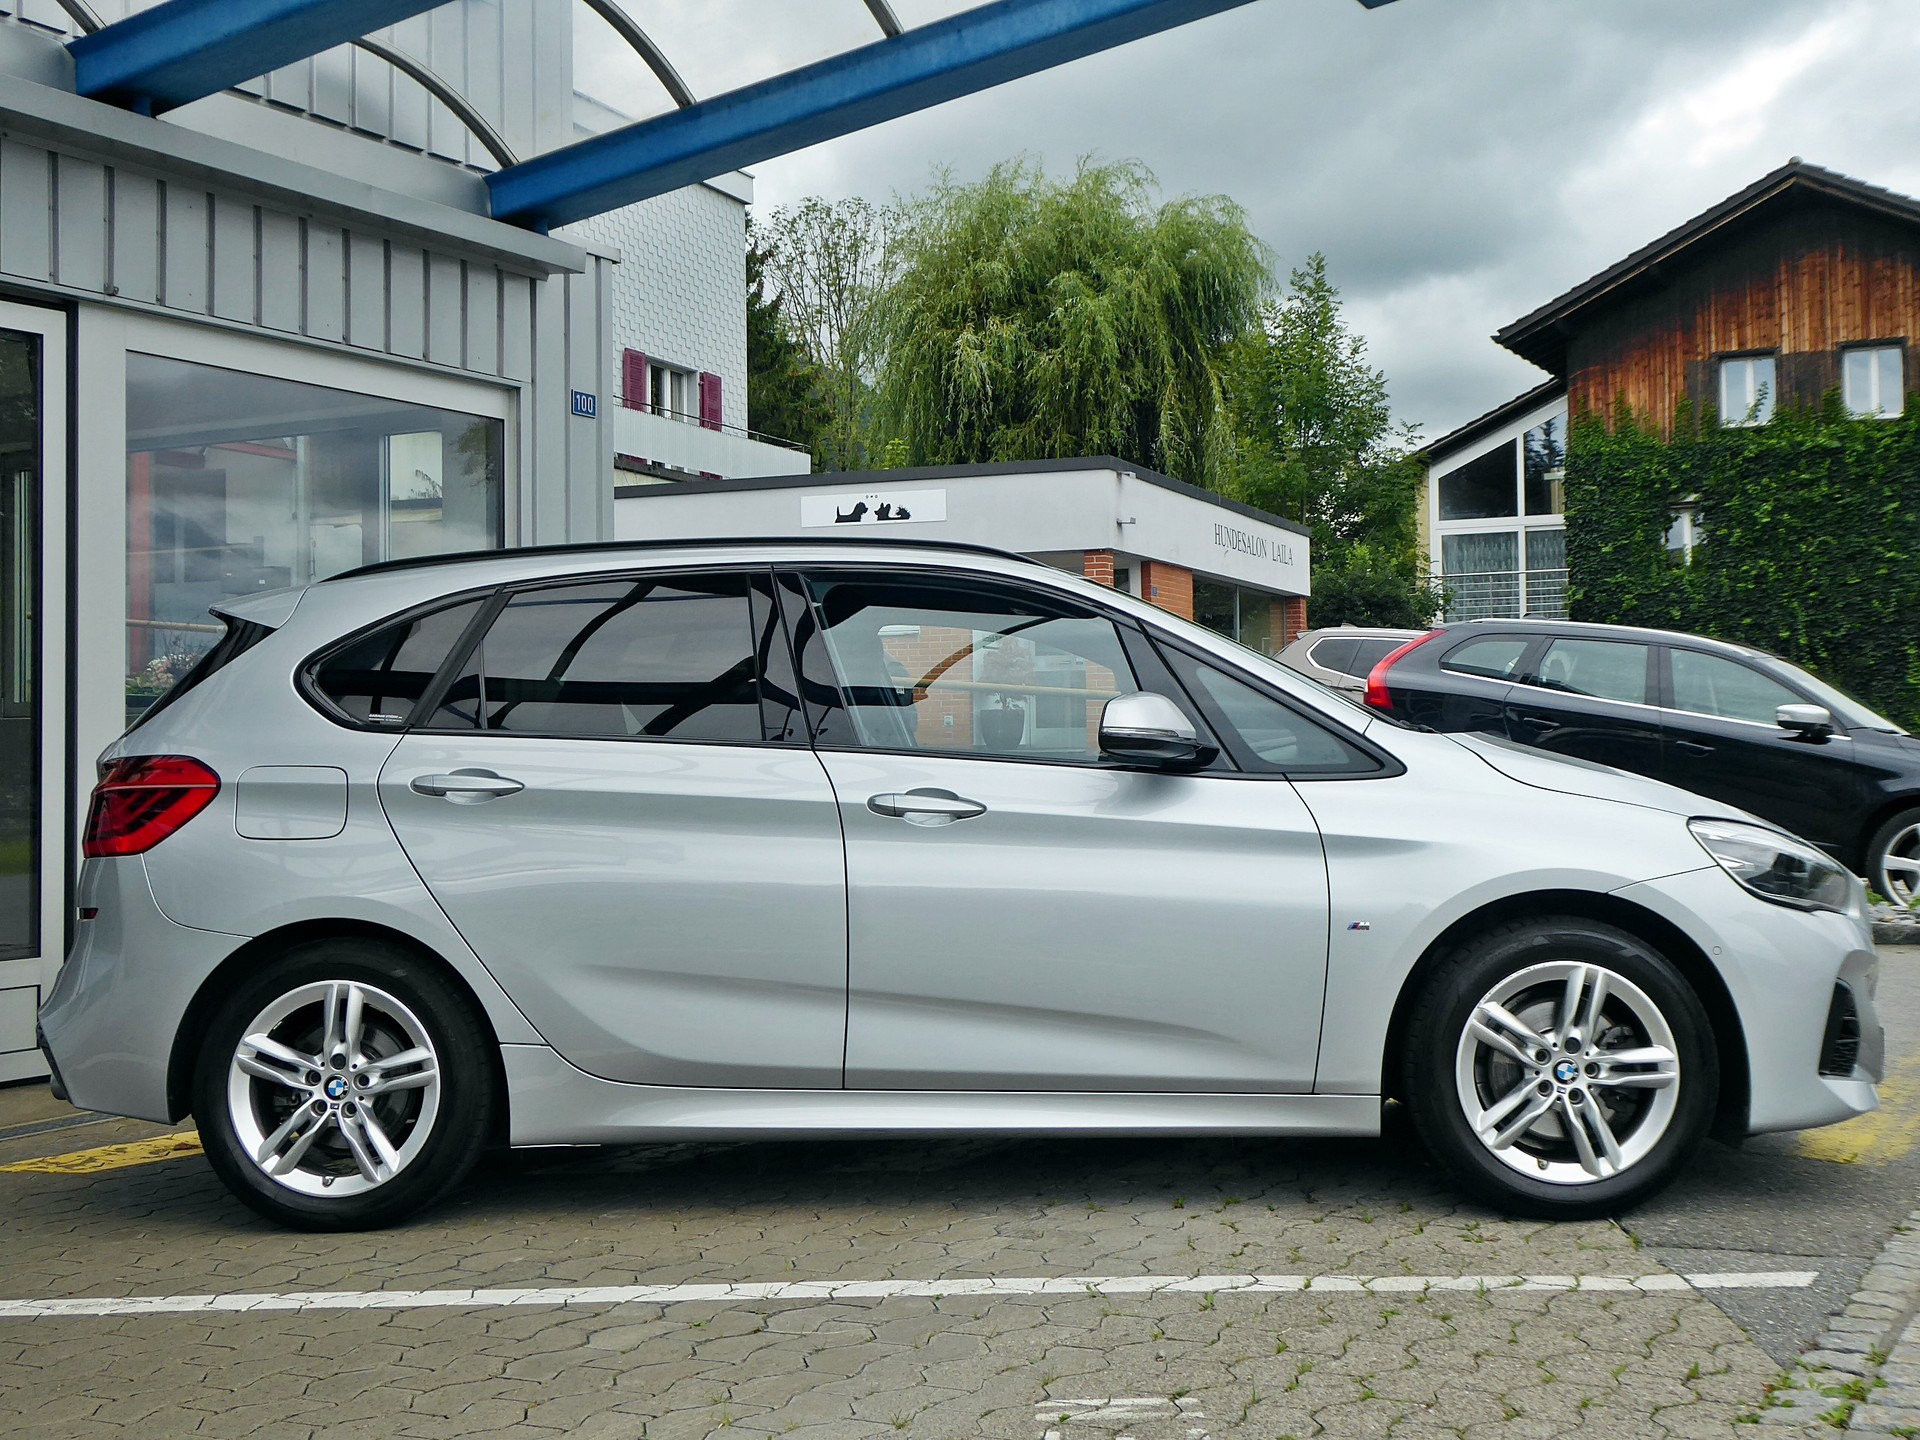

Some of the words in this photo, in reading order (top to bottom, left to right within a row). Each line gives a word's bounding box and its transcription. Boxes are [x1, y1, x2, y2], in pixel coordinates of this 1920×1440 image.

[576, 394, 593, 413] 100
[1214, 523, 1267, 559] HUNDESALON
[1272, 541, 1293, 566] LAILA
